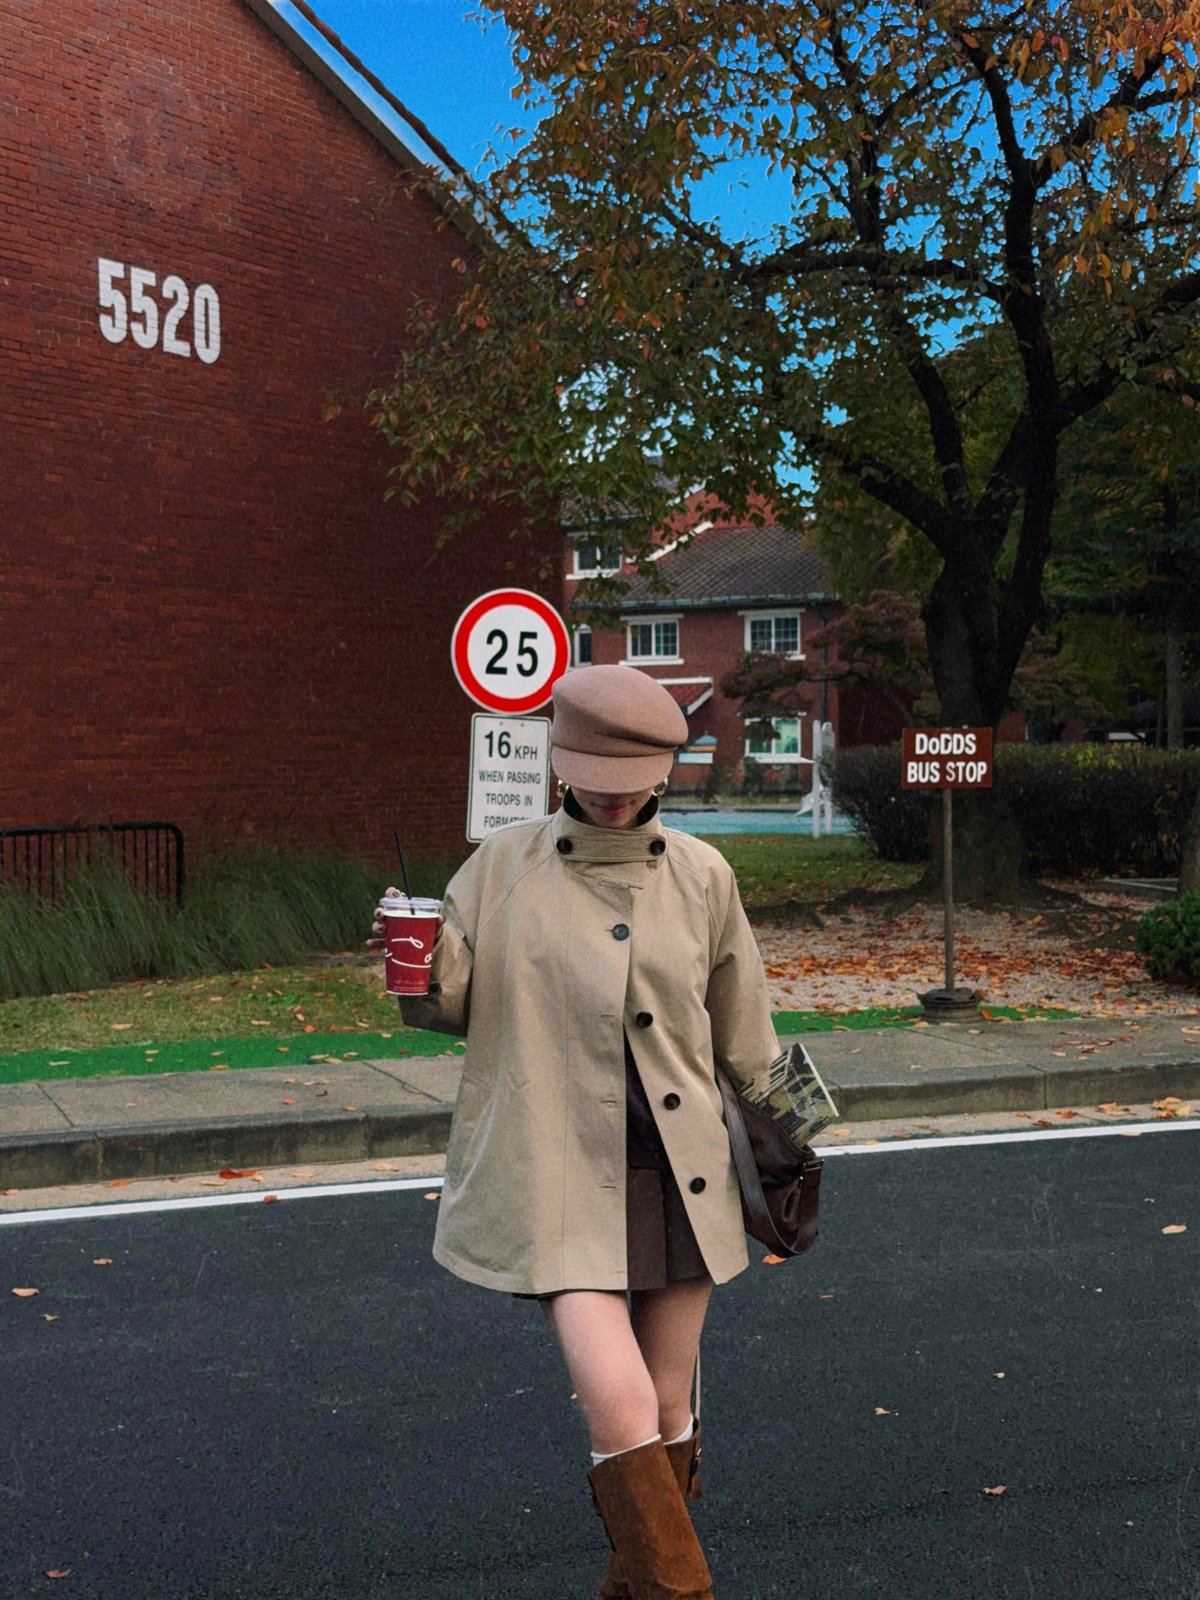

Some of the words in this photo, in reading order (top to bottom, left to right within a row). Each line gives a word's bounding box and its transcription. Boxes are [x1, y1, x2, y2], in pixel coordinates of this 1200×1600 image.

[98, 257, 221, 364] 5520
[485, 629, 539, 677] 25
[484, 730, 512, 759] 16
[514, 745, 538, 760] KPH
[915, 733, 977, 755] DoDDS
[479, 770, 504, 783] WHEN
[507, 771, 541, 785] PASSING
[907, 761, 941, 784] BUS
[945, 761, 988, 783] STOP
[486, 793, 521, 807] TROOPS
[524, 795, 533, 807] IN
